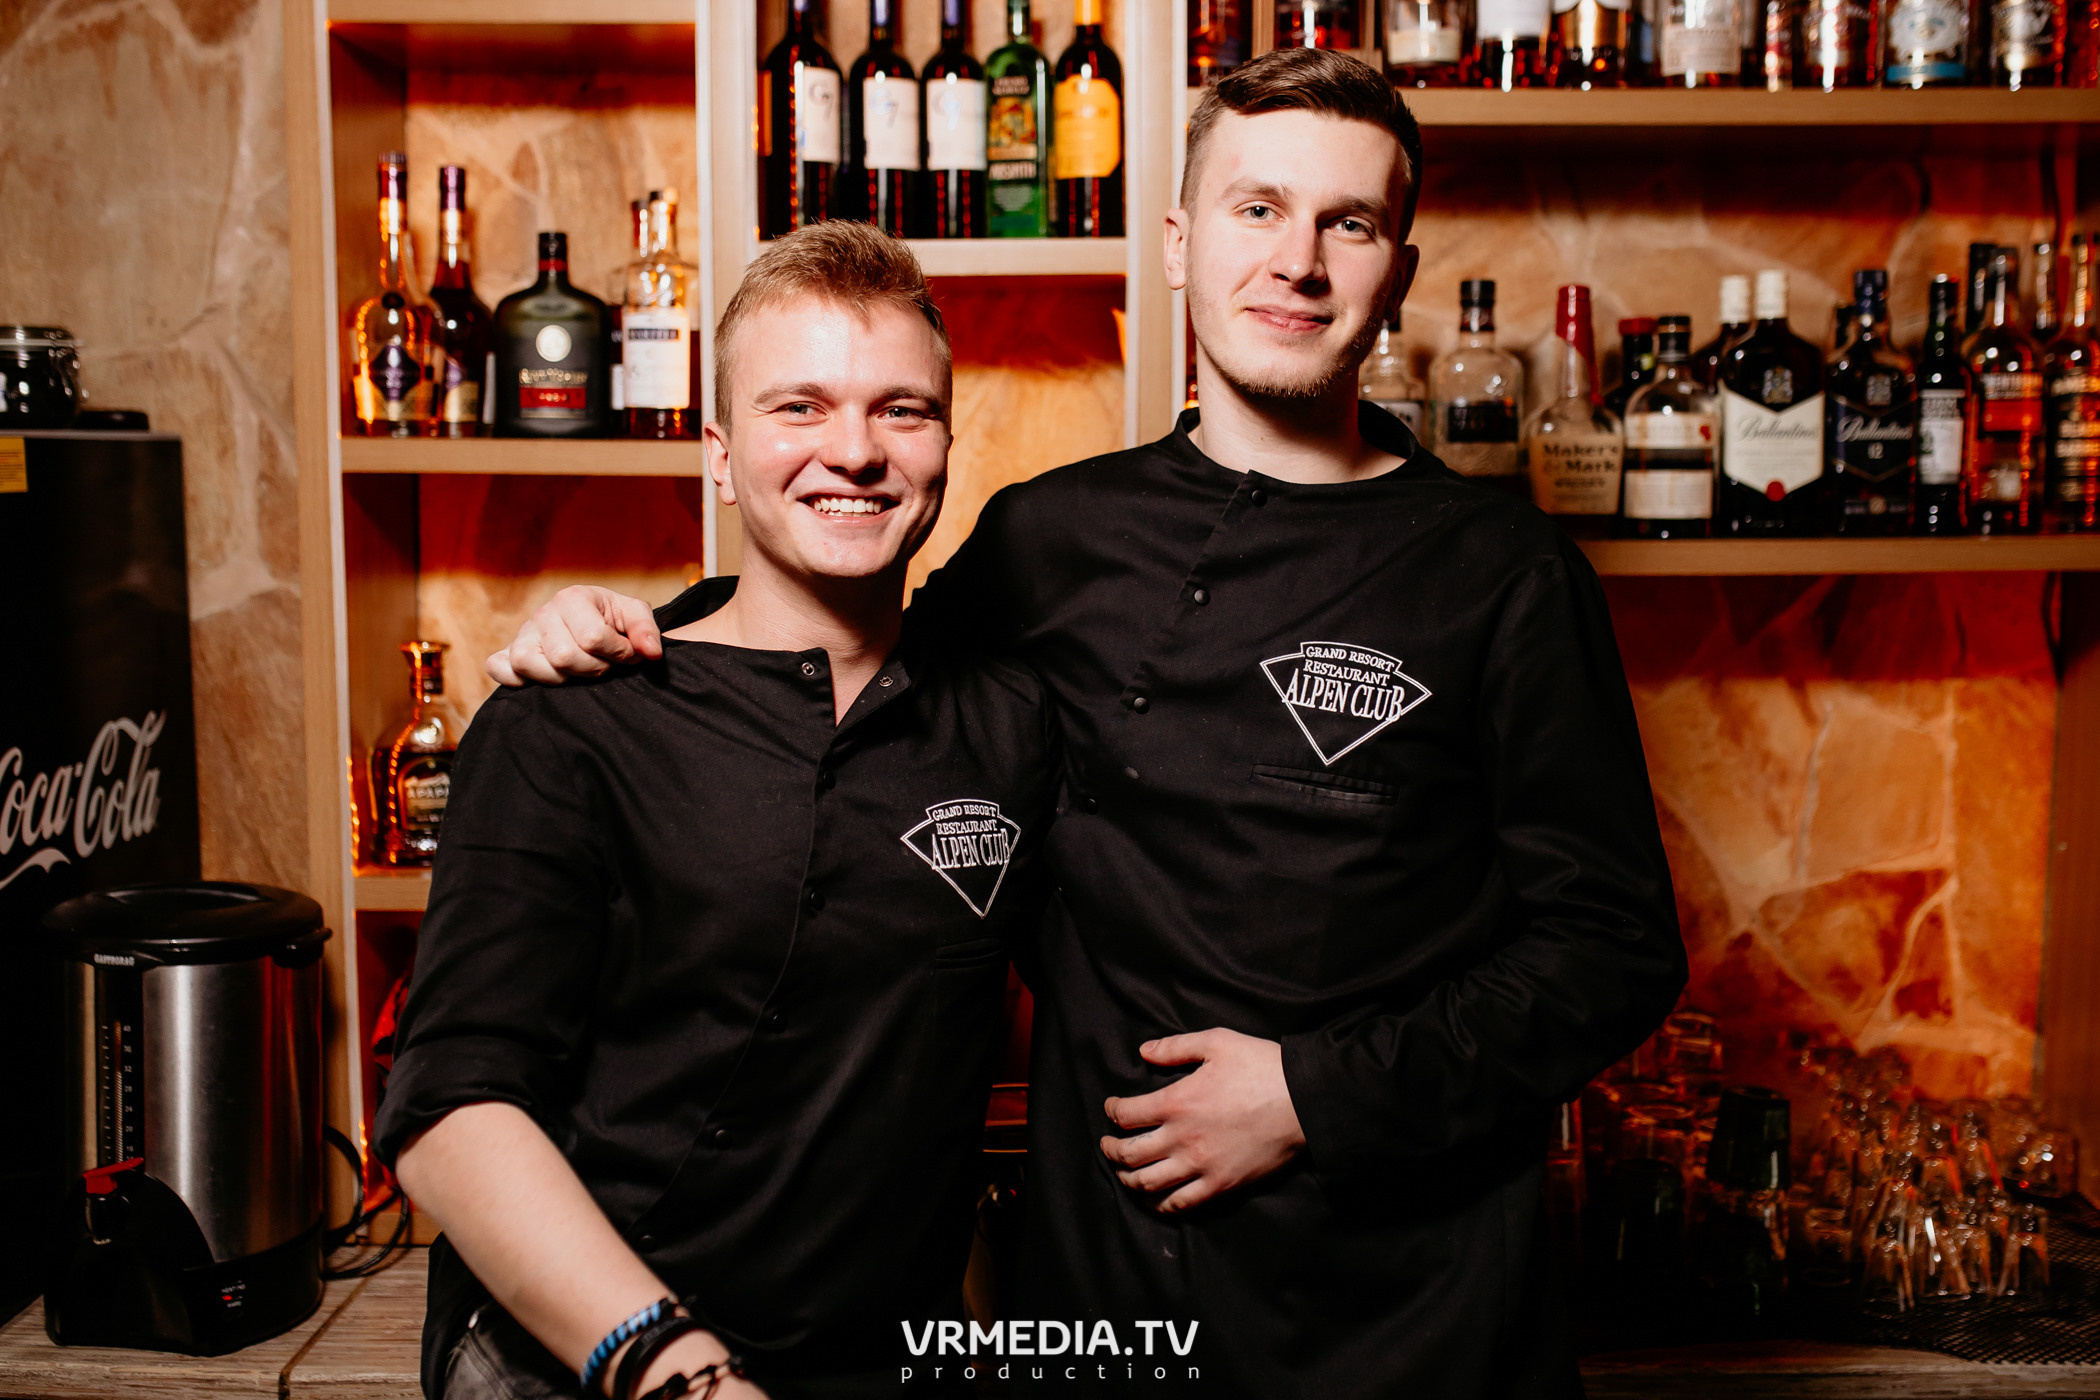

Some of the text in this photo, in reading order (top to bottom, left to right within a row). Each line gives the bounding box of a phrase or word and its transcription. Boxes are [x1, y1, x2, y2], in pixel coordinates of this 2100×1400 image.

[1565, 459, 1617, 473] Mark
[1303, 659, 1391, 687] RESTAURANT
[1306, 646, 1395, 673] GRAND RESORT
[1281, 668, 1405, 723] ALPEN CLUB
[932, 804, 998, 821] GRAND RESORT
[936, 819, 998, 836] RESTAURANT
[932, 828, 1010, 870] ALPEN CLUB
